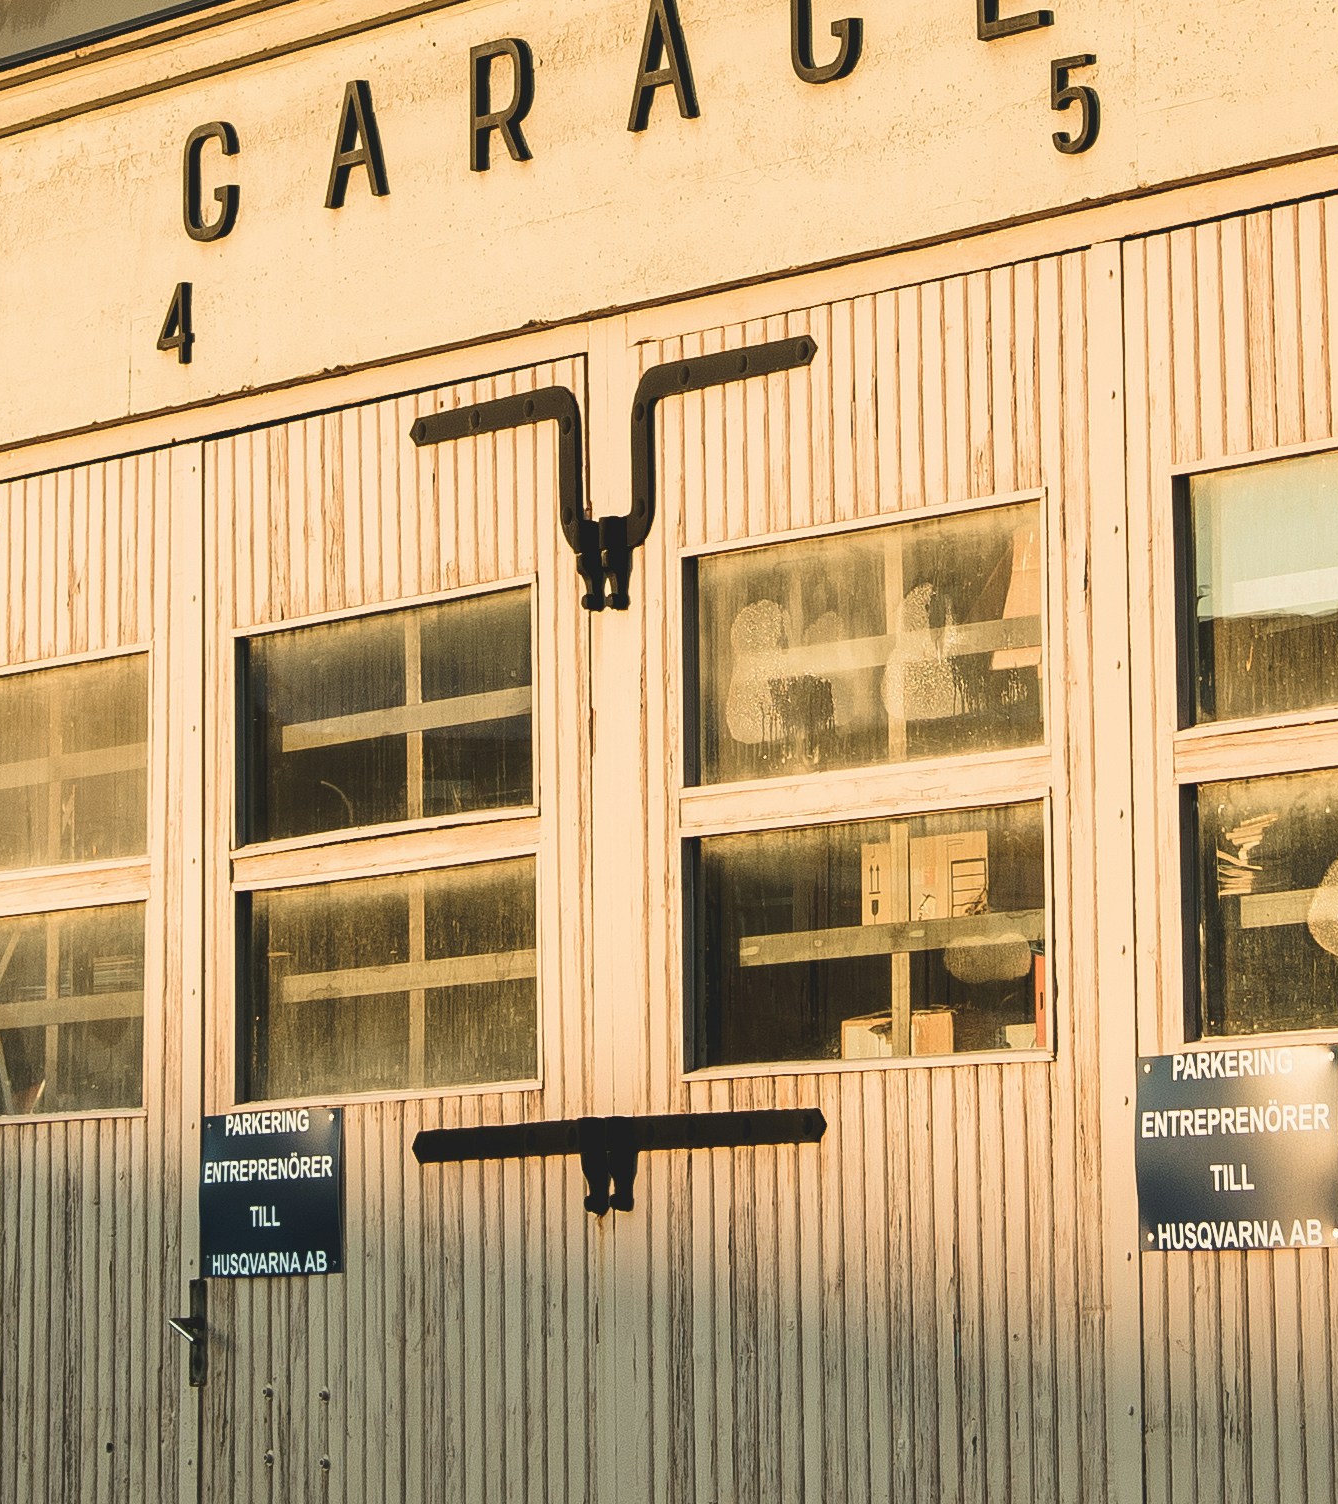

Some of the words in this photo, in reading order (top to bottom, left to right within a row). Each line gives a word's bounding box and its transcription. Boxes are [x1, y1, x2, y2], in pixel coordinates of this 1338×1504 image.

[1050, 54, 1101, 155] 5
[156, 282, 196, 365] 4
[1172, 1049, 1293, 1082] PARKERING
[225, 1109, 310, 1136] PARKERING
[1141, 1099, 1330, 1139] ENTREPRENÖRER
[204, 1151, 333, 1184] ENTREPRENÖRER
[1210, 1164, 1255, 1192] TILL
[249, 1205, 281, 1228] TILL
[1157, 1219, 1286, 1250] HUSQVARNA
[1289, 1218, 1323, 1246] AB
[212, 1252, 301, 1276] HUSQVARNA
[304, 1250, 328, 1273] AB
